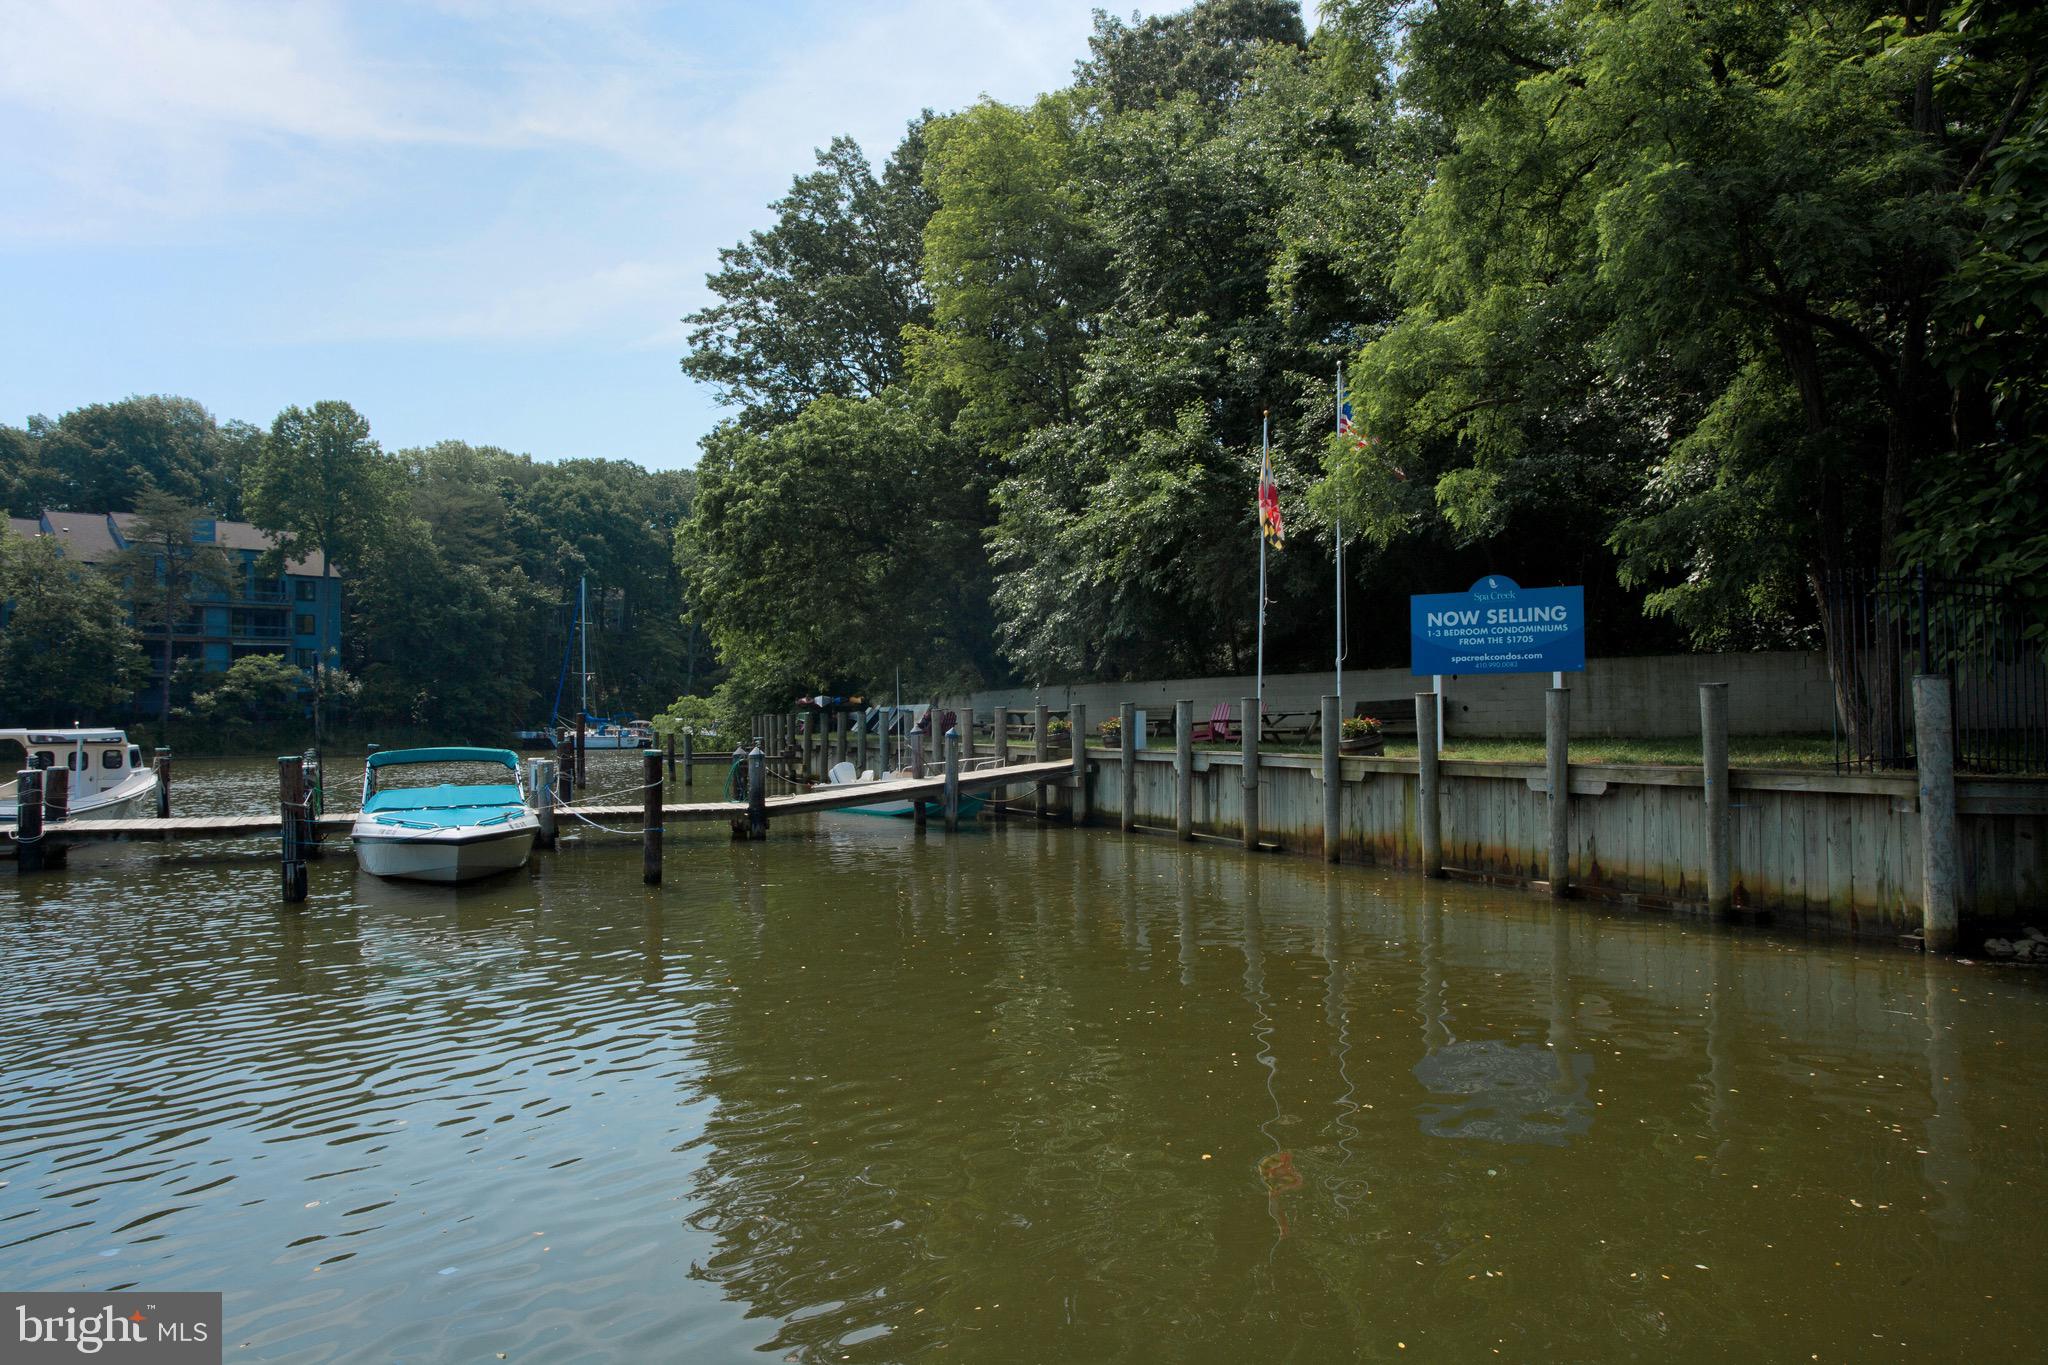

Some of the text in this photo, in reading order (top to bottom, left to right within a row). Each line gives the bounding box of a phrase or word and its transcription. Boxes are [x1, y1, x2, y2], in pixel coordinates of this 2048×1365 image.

[1473, 590, 1517, 602] Spa Creek
[1427, 605, 1567, 627] NOW SELLING
[1427, 624, 1568, 638] 1-3 BEDROOM CONDOMINIUMS
[1458, 637, 1485, 646] FROM
[1487, 636, 1503, 645] THE
[1451, 652, 1543, 663] spacreekcondos.com
